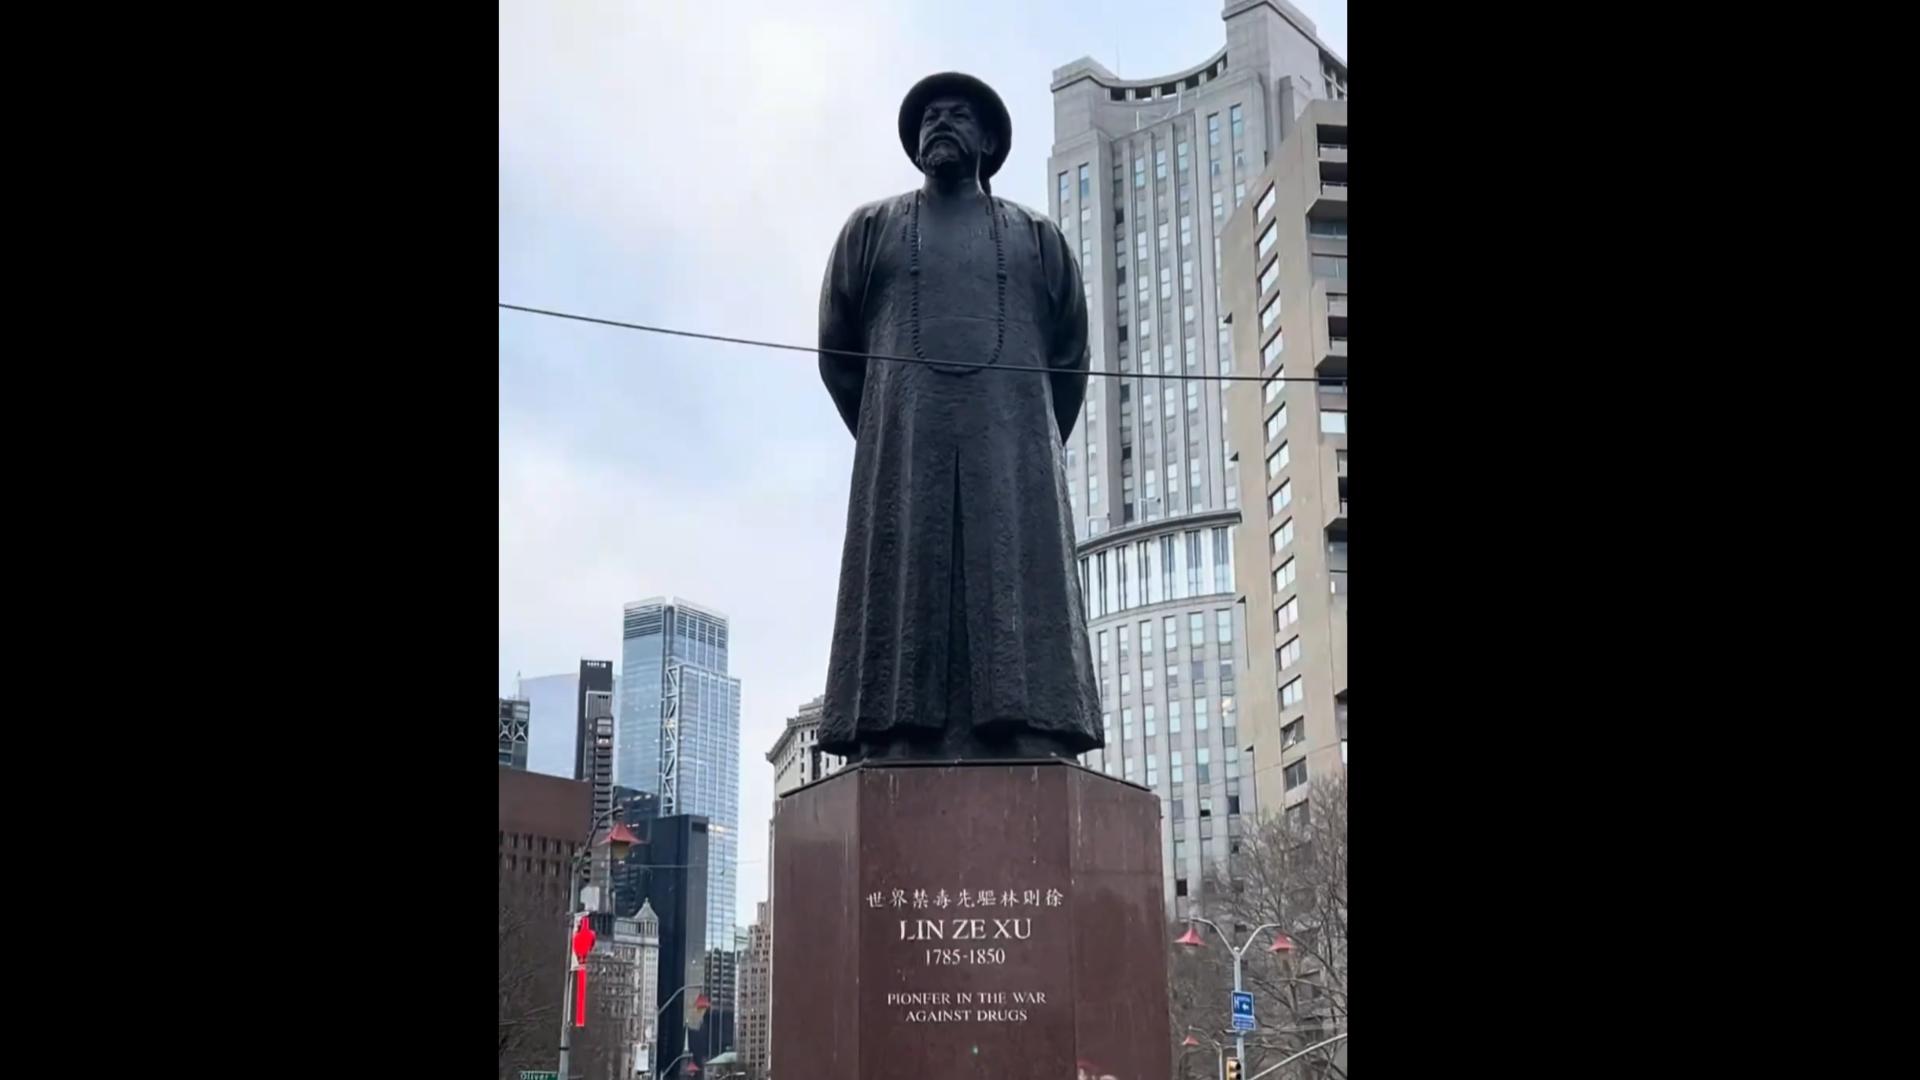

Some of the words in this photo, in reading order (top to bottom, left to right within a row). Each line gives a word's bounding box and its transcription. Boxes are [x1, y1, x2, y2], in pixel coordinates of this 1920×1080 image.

[900, 919, 944, 940] LIN
[952, 919, 986, 940] ZE
[993, 918, 1032, 940] XU
[925, 949, 1006, 965] 1785-1850
[887, 992, 951, 1005] PIONEER
[957, 992, 972, 1004] IN
[977, 992, 1006, 1004] THE
[1013, 992, 1047, 1004] WAR
[905, 1010, 972, 1022] AGAINST
[977, 1010, 1028, 1022] DRUGS
